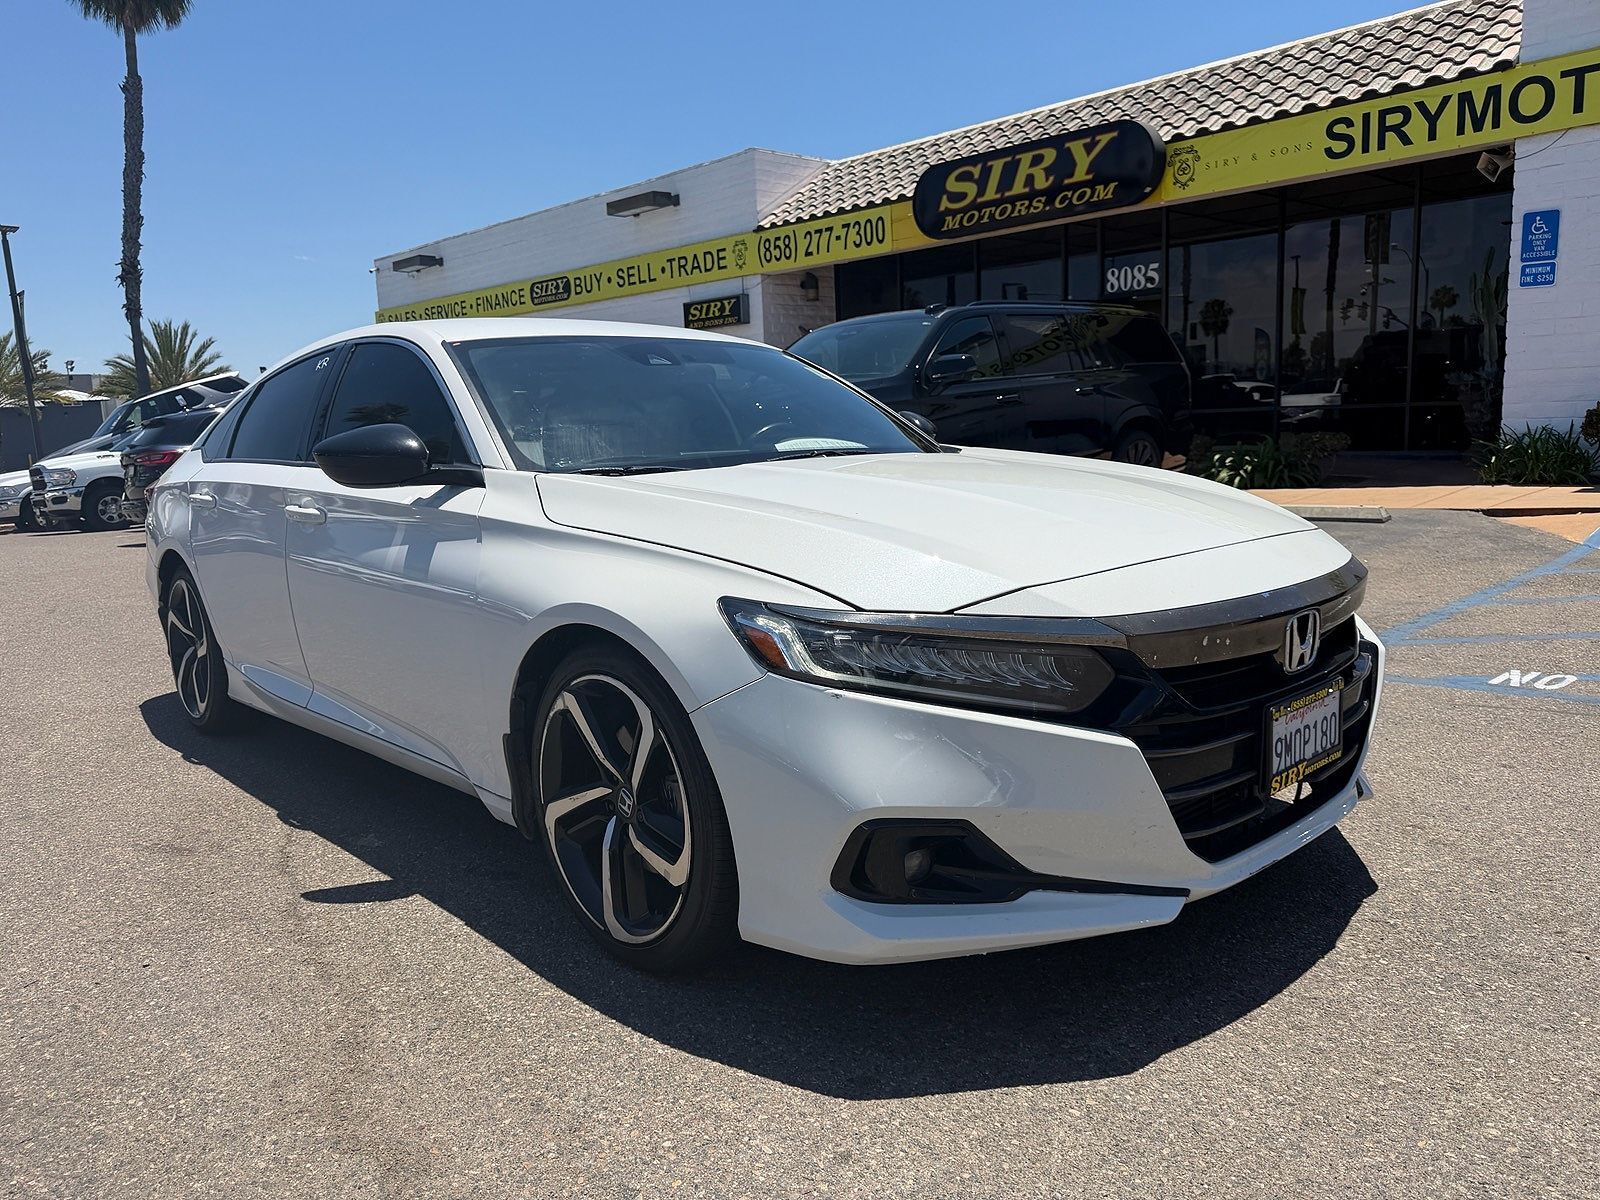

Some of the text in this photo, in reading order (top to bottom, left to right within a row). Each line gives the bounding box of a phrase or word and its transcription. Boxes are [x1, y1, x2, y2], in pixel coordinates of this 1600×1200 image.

[1324, 64, 1600, 159] SIRYMOT
[938, 130, 1119, 212] SIRY
[1204, 155, 1240, 171] SIRY
[1269, 141, 1313, 158] SONS
[941, 182, 1118, 231] MOTORS.COM
[757, 216, 886, 268] (858) 277-7300
[1528, 233, 1552, 241] PARKING
[1522, 249, 1556, 258] ACCESSIBLE
[573, 248, 727, 295] BUY SELL TRADE
[1106, 263, 1160, 293] 8085
[1521, 274, 1554, 283] FINE $250
[1525, 266, 1551, 274] MINIMUM
[532, 278, 568, 298] SIRY
[424, 300, 468, 320] SERVICE
[476, 288, 526, 313] FINANCE
[688, 299, 737, 321] SIRY
[689, 320, 704, 329] AND
[704, 318, 725, 327] SONS
[1488, 669, 1578, 690] NO
[1274, 711, 1337, 774] 9MOP180
